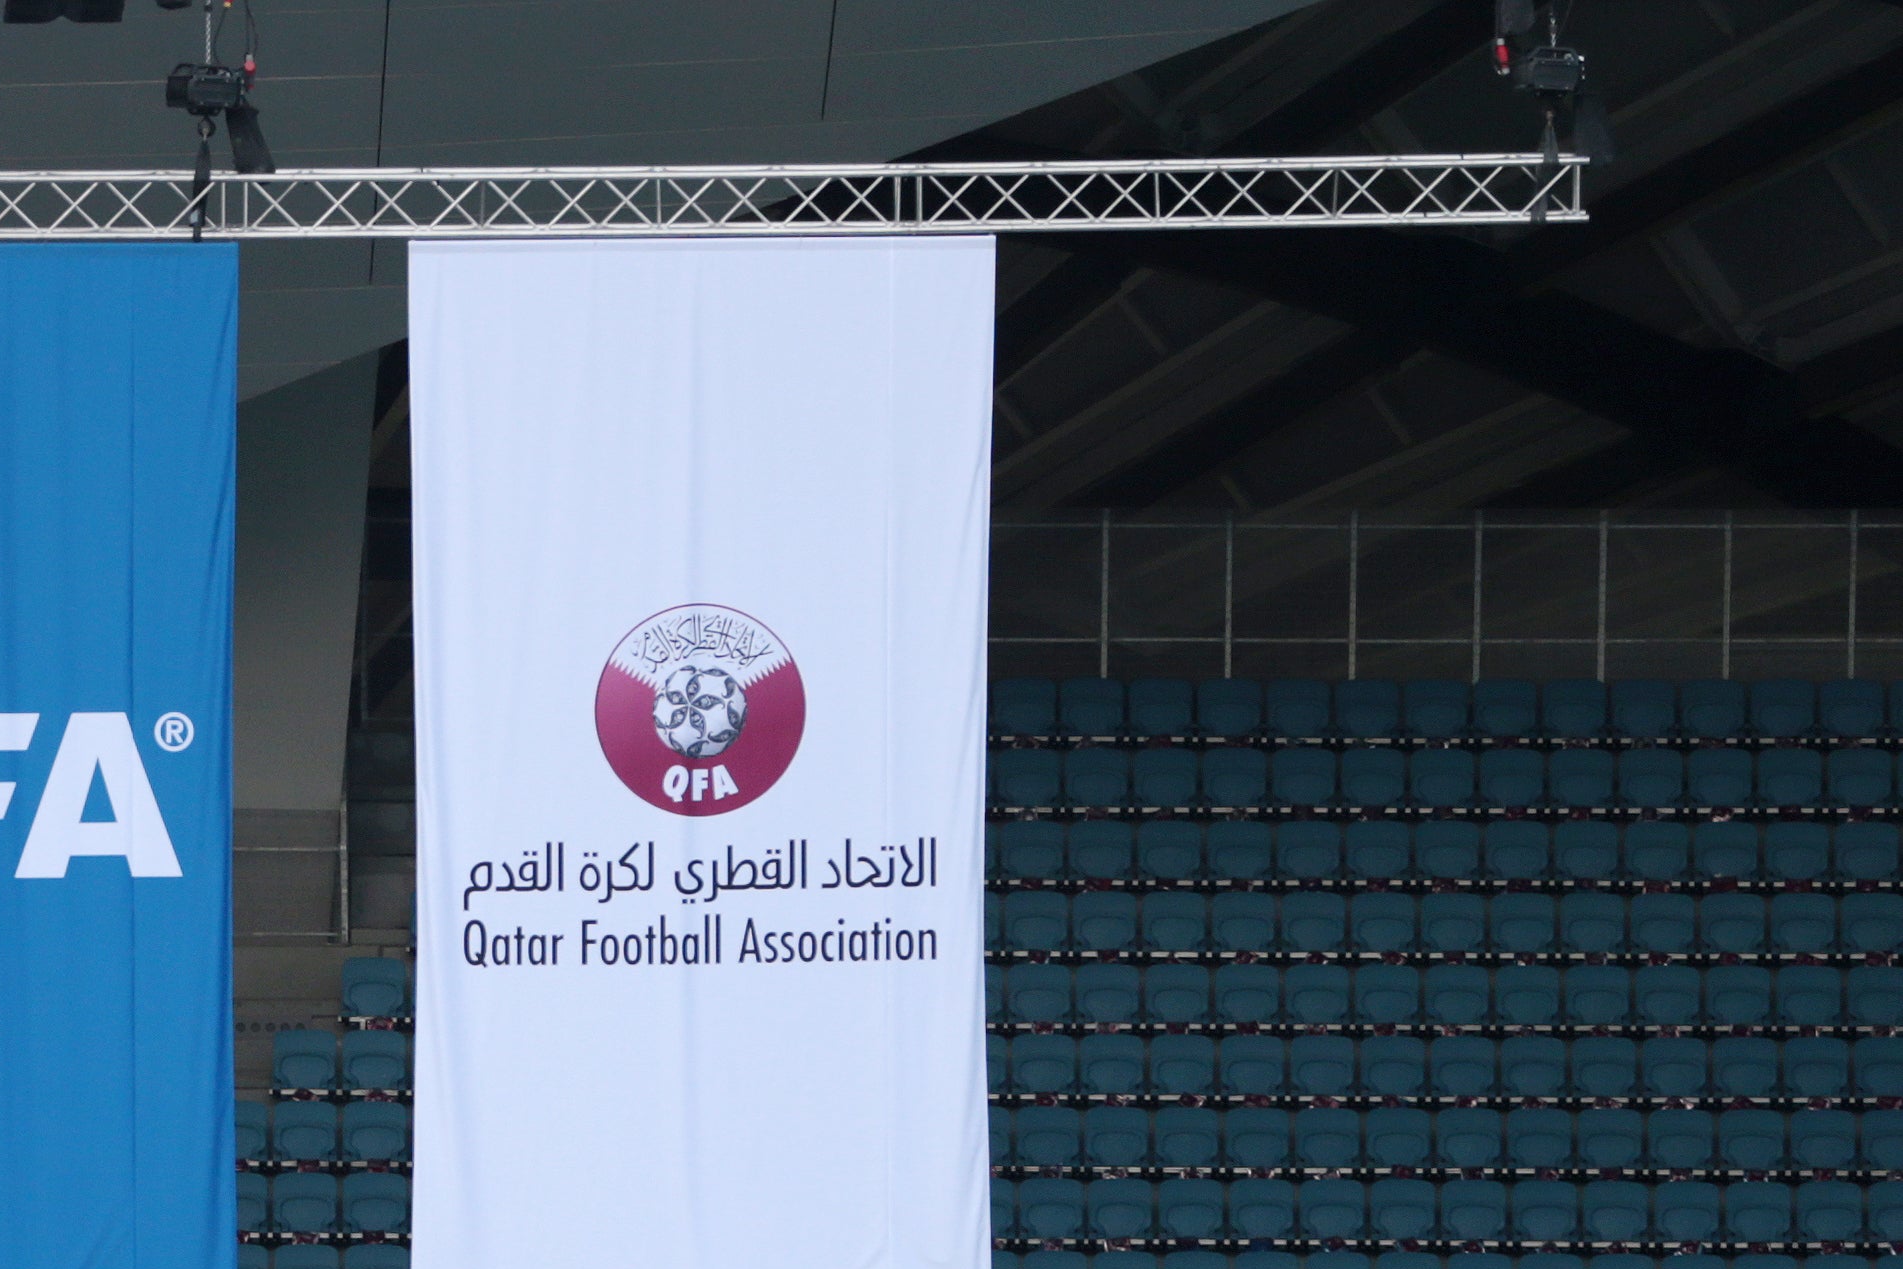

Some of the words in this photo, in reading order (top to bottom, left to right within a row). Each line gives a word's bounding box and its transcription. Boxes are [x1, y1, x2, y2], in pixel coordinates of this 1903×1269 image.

[662, 764, 739, 802] QFA
[463, 842, 564, 911] القدم
[579, 841, 655, 903] لكرة
[674, 839, 807, 905] القطري
[822, 837, 937, 888] الاتحاد
[463, 919, 564, 967] Qatar
[581, 913, 721, 966] Football
[739, 917, 937, 964] Association
